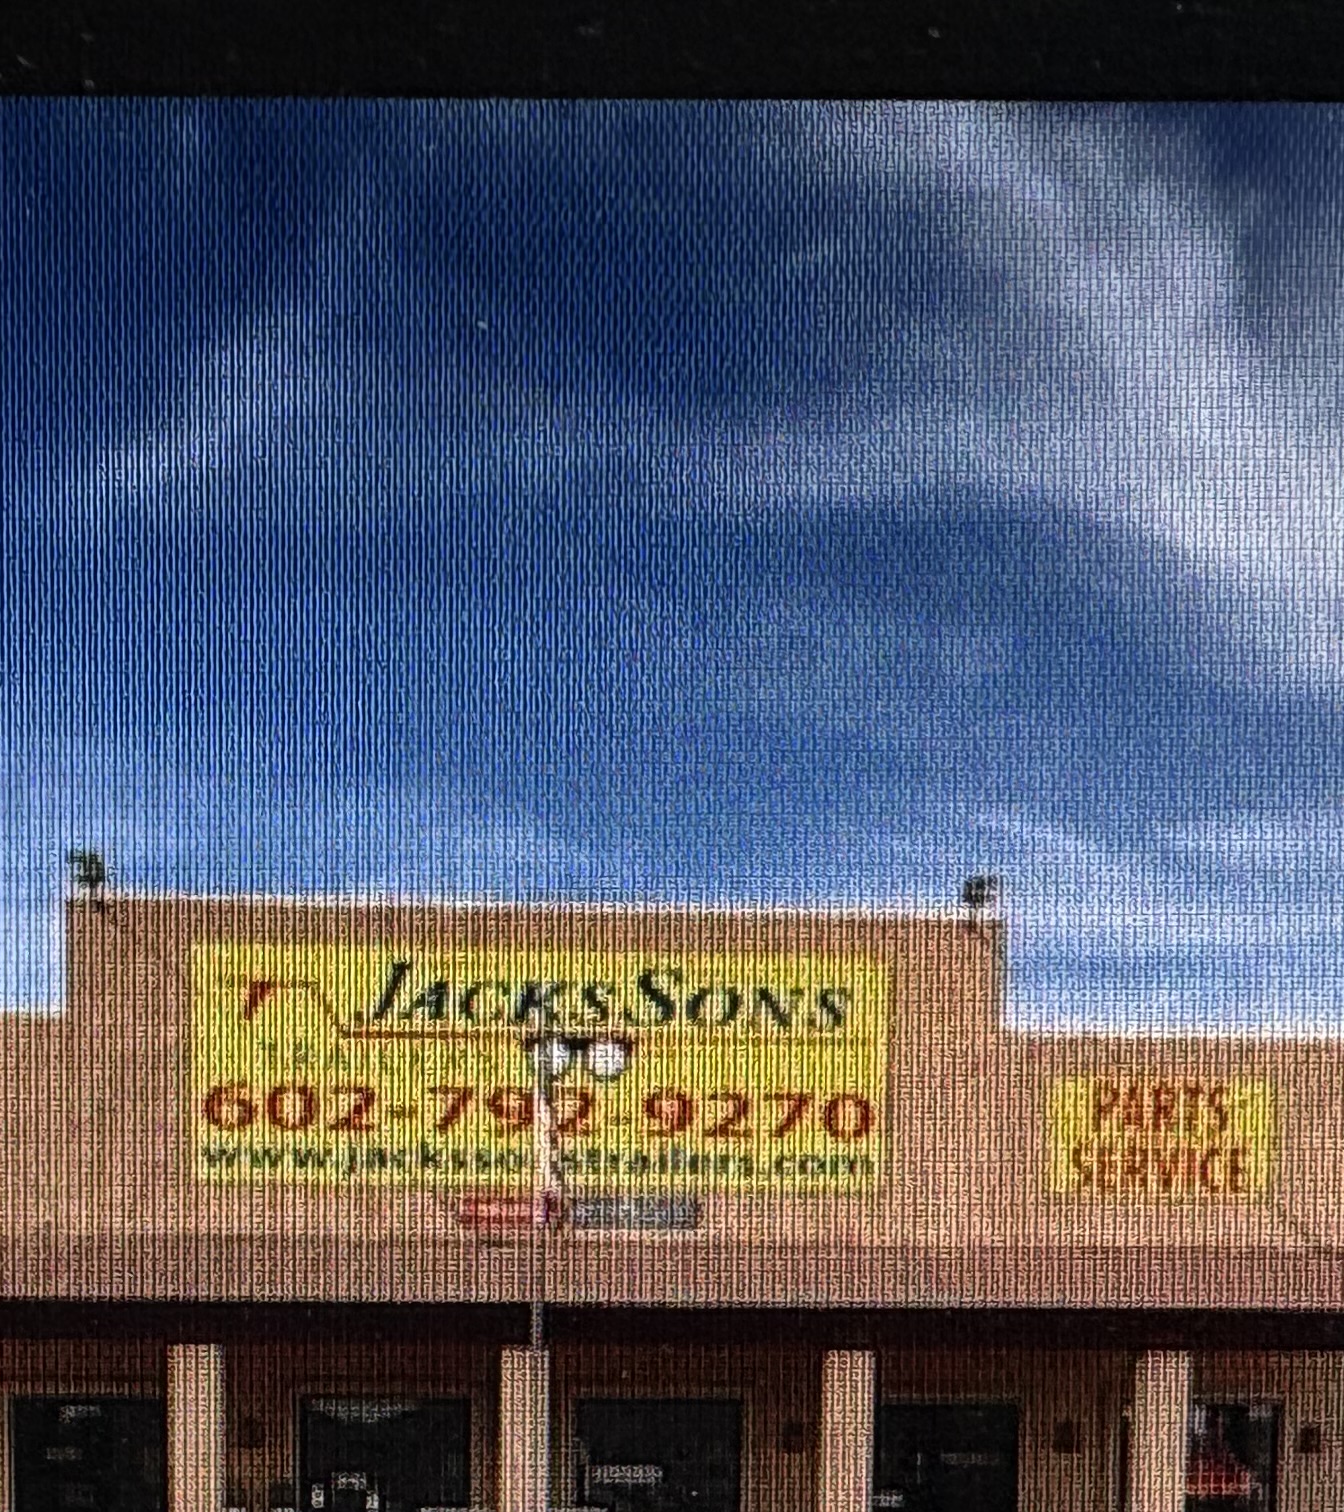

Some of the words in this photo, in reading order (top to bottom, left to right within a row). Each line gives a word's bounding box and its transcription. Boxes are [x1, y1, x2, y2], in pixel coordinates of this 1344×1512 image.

[202, 1079, 875, 1141] 602-792-9270
[1093, 1080, 1228, 1136] PARTS
[1070, 1142, 1250, 1194] SERVICE
